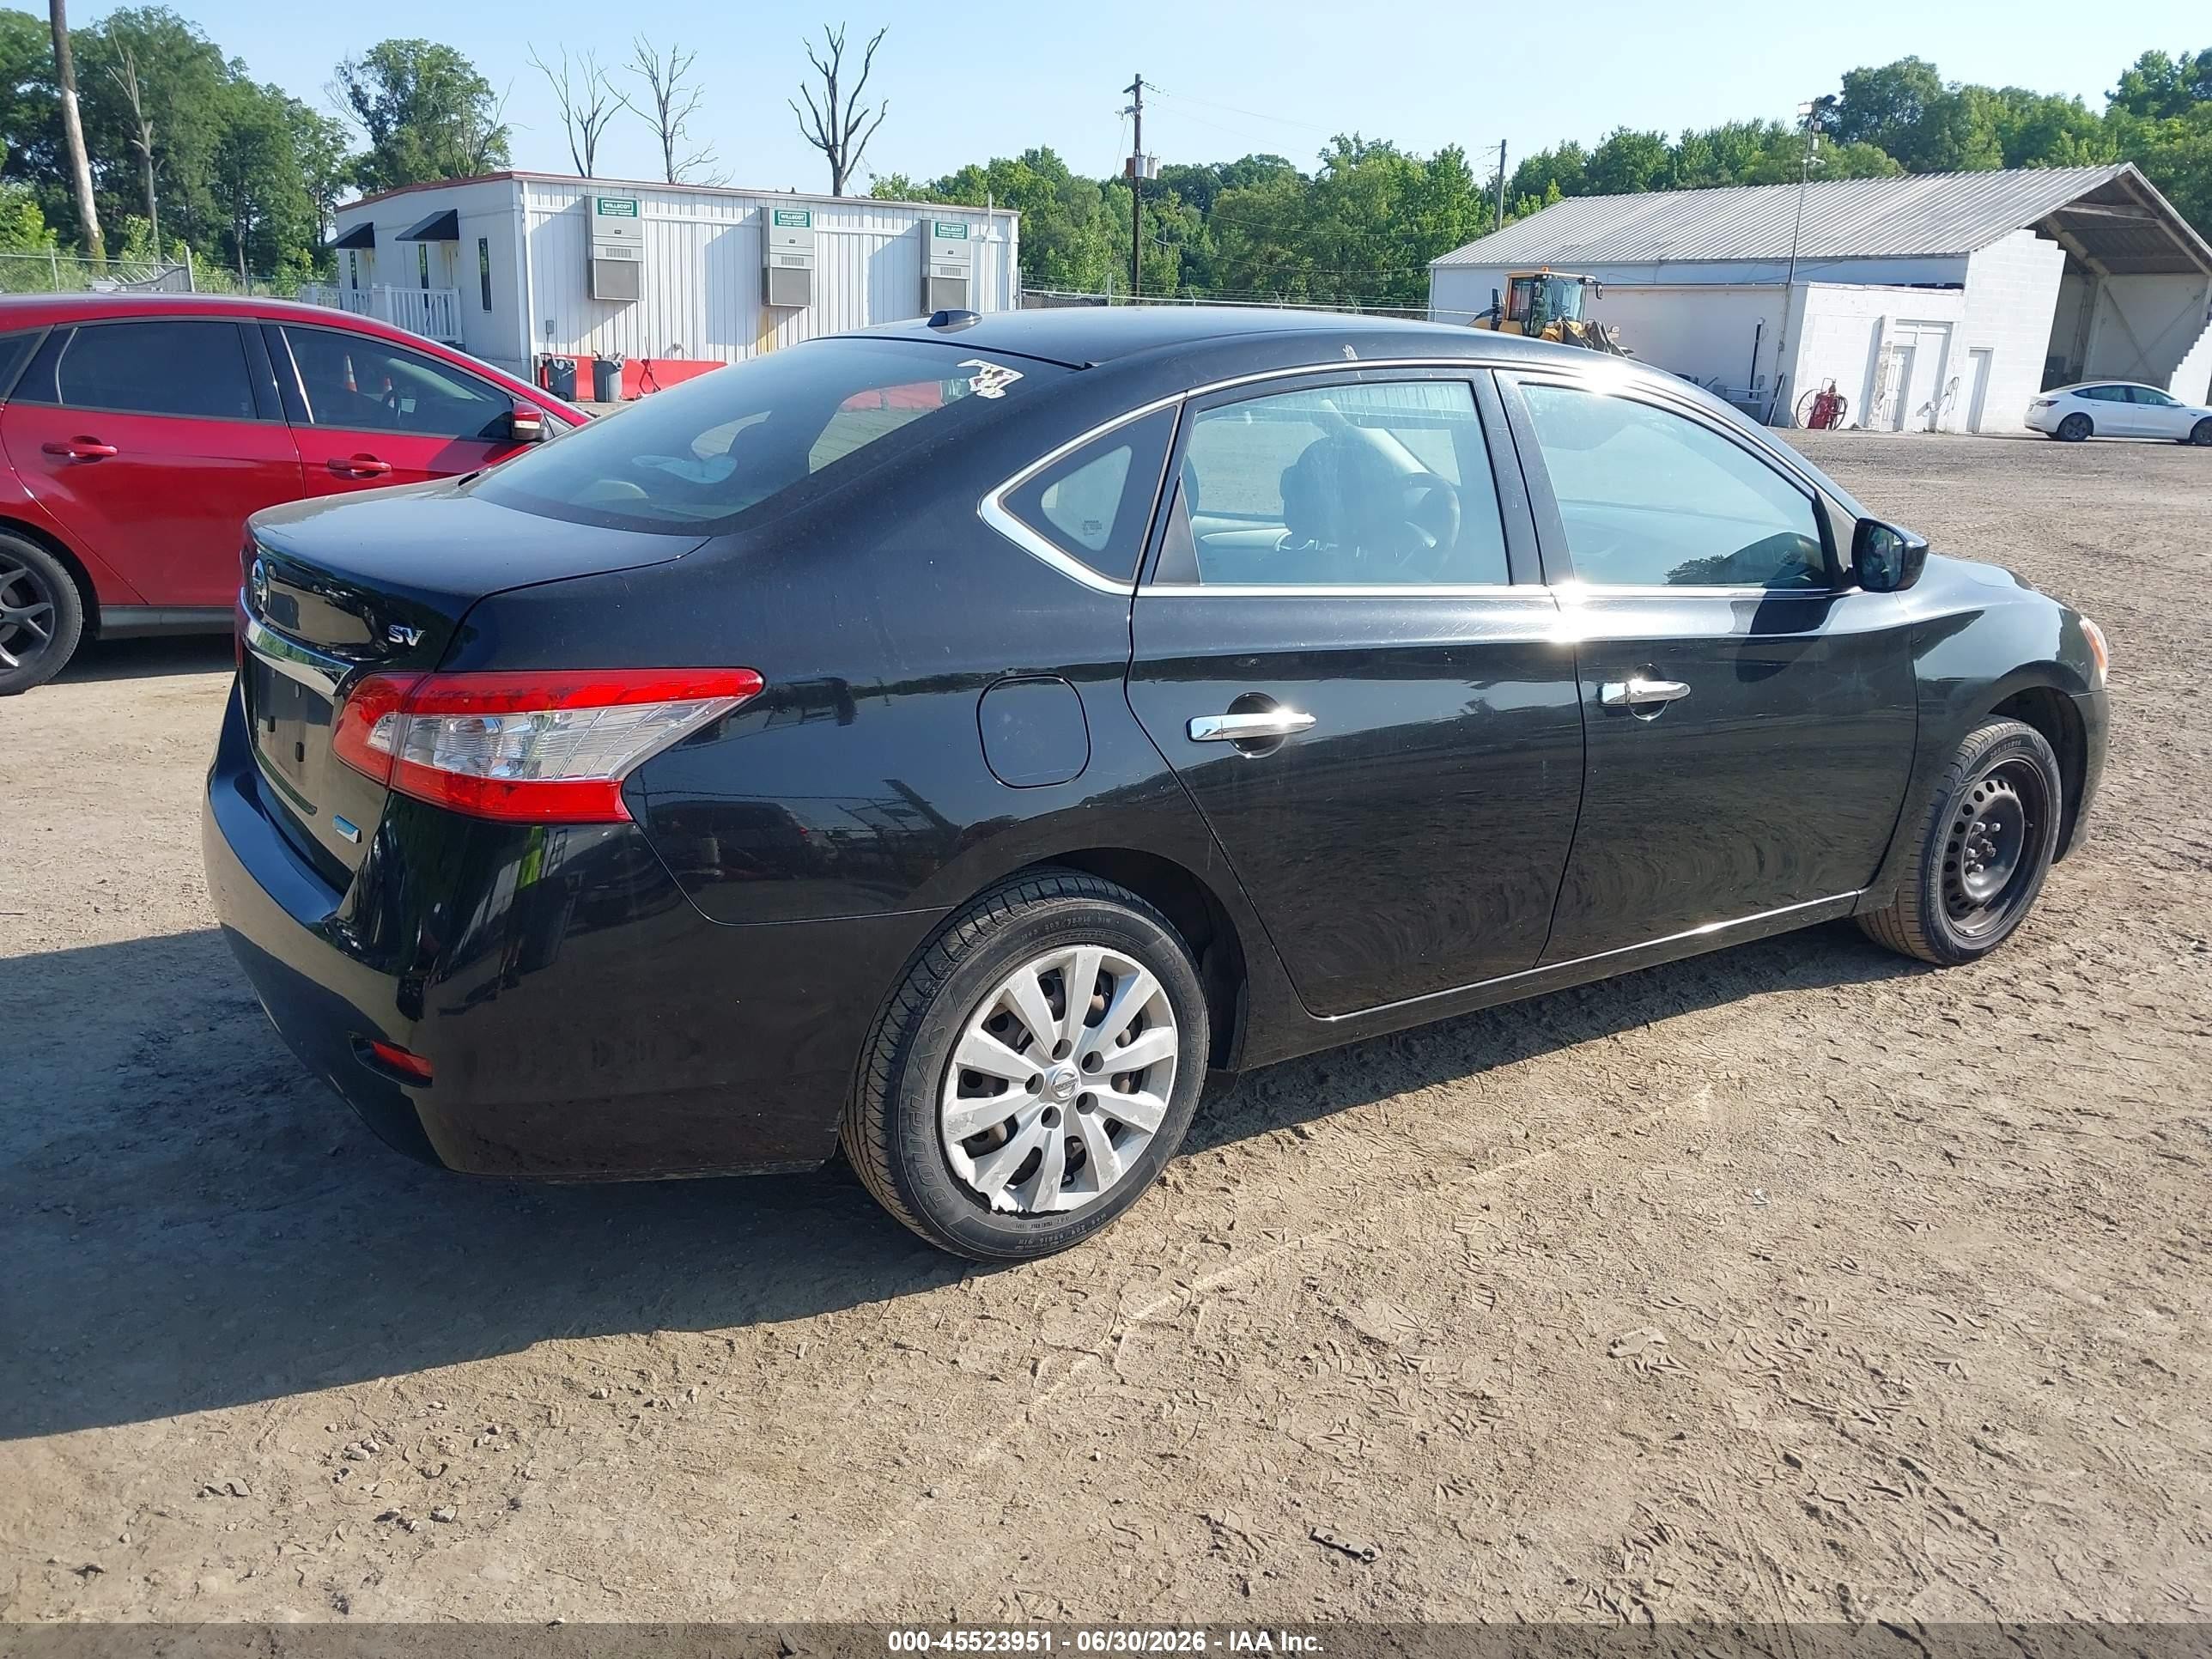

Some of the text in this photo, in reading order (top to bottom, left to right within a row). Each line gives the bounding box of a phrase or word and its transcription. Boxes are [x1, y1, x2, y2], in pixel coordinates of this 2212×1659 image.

[388, 624, 426, 646] SV
[1054, 1078, 1079, 1092] NISSAN
[908, 1017, 955, 1209] DOUGLAS
